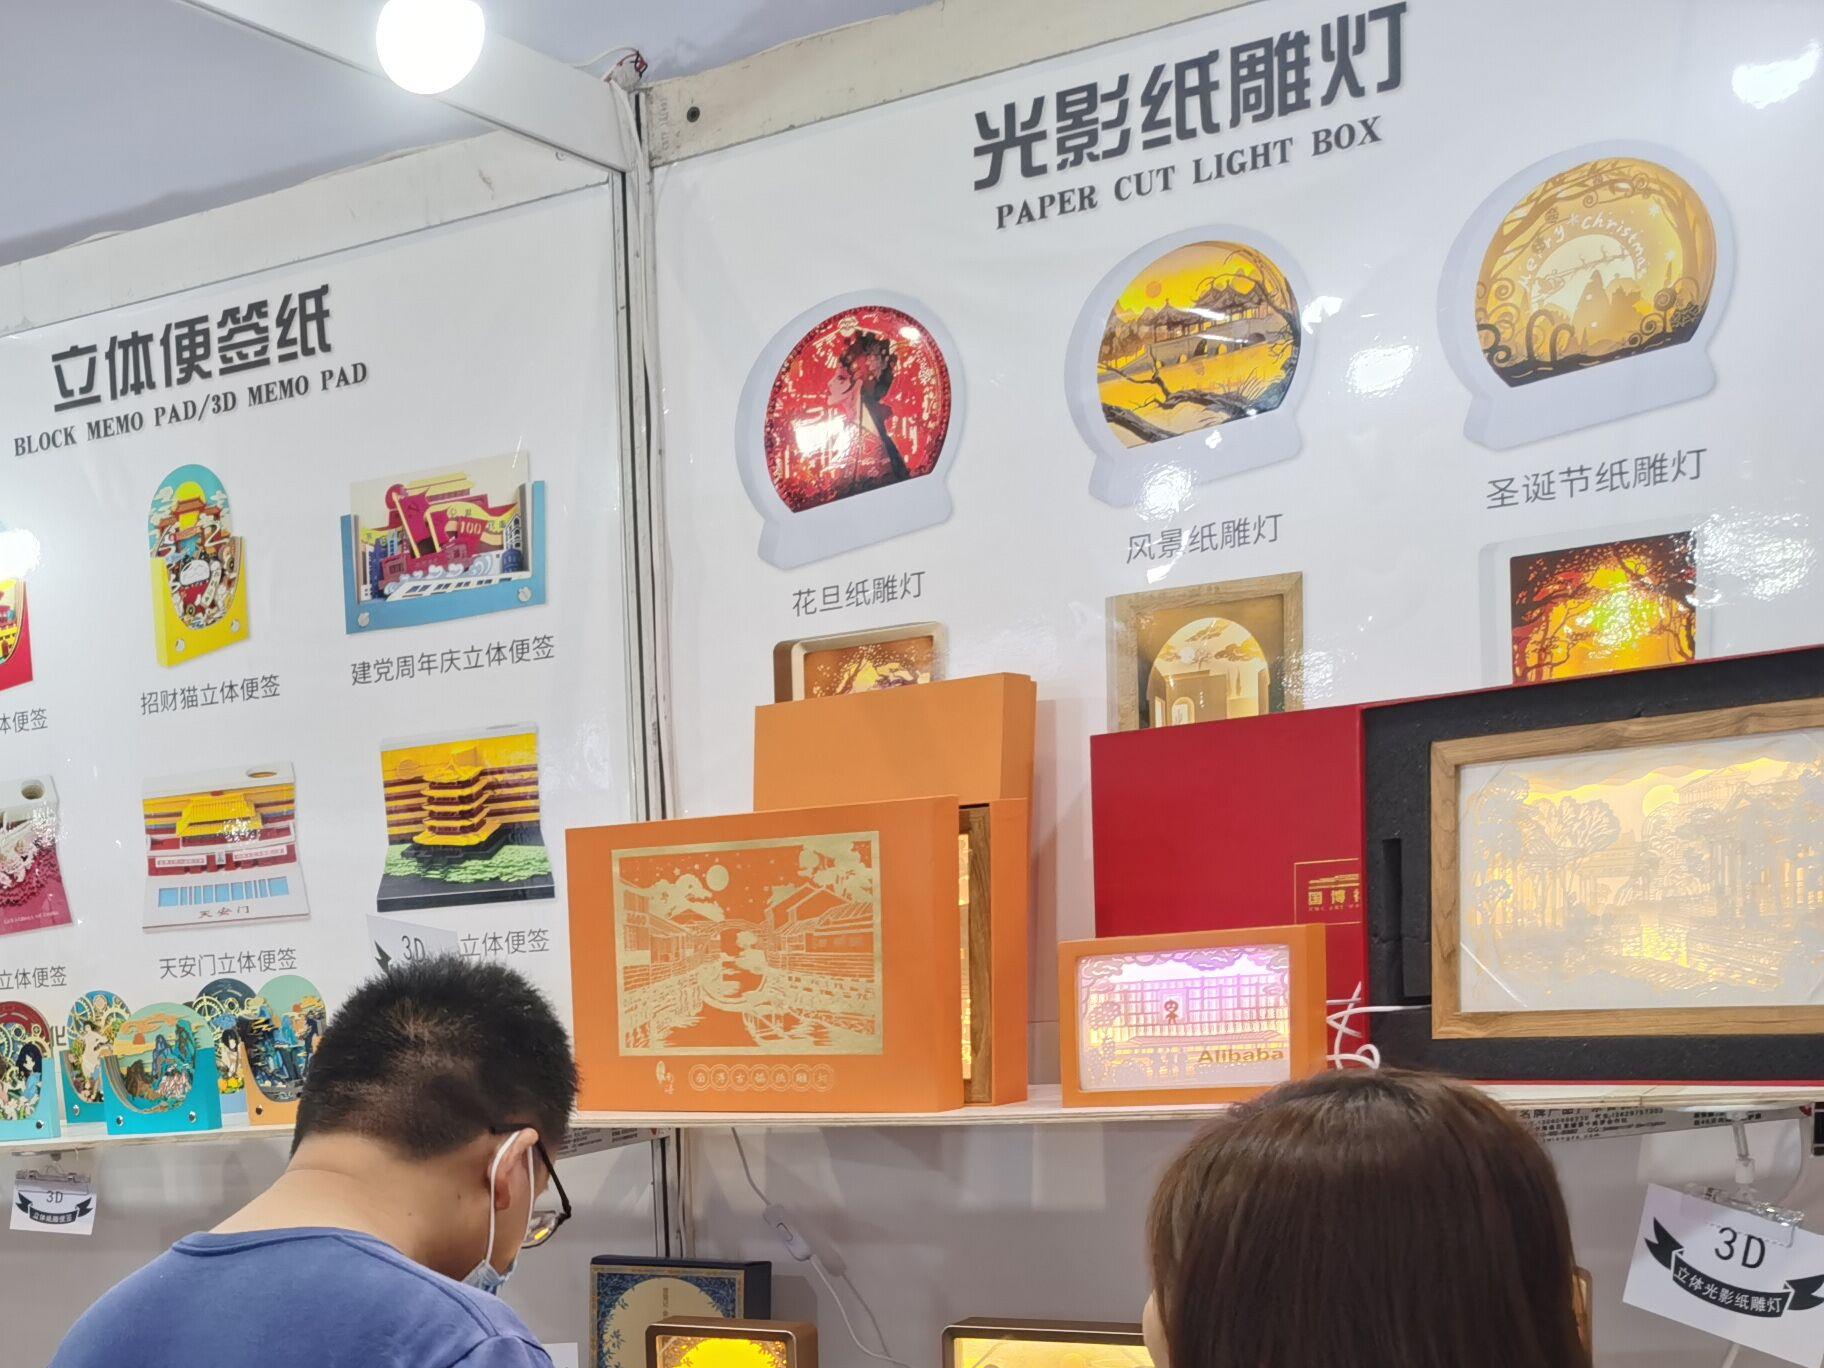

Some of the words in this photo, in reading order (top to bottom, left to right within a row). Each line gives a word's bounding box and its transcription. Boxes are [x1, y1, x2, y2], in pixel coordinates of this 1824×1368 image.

[973, 1, 1409, 191] 光影纸雕灯
[995, 186, 1098, 230] PAPER
[1113, 164, 1176, 201] CUT
[1192, 136, 1294, 185] LIGHT
[1311, 114, 1384, 157] BOX
[51, 283, 332, 413] 立体便签纸
[13, 425, 77, 458] BLOCK
[87, 411, 144, 442] MEMO
[154, 390, 237, 427] PAD/3D
[248, 375, 310, 407] MEMO
[321, 361, 368, 391] PAD
[1486, 447, 1708, 510] 圣诞节纸雕灯
[1126, 513, 1283, 565] 风景纸雕灯
[792, 570, 926, 618] 花旦纸雕灯
[349, 634, 556, 686] 建党周年庆立体便签
[139, 673, 282, 715] 招财猫立体便签
[159, 947, 298, 980] 天安门立体便签
[1198, 1048, 1284, 1062] Alibaba
[46, 1190, 64, 1204] 3D
[1714, 1226, 1766, 1269] 3D
[1674, 1266, 1783, 1314] 立体光影纸雕灯
